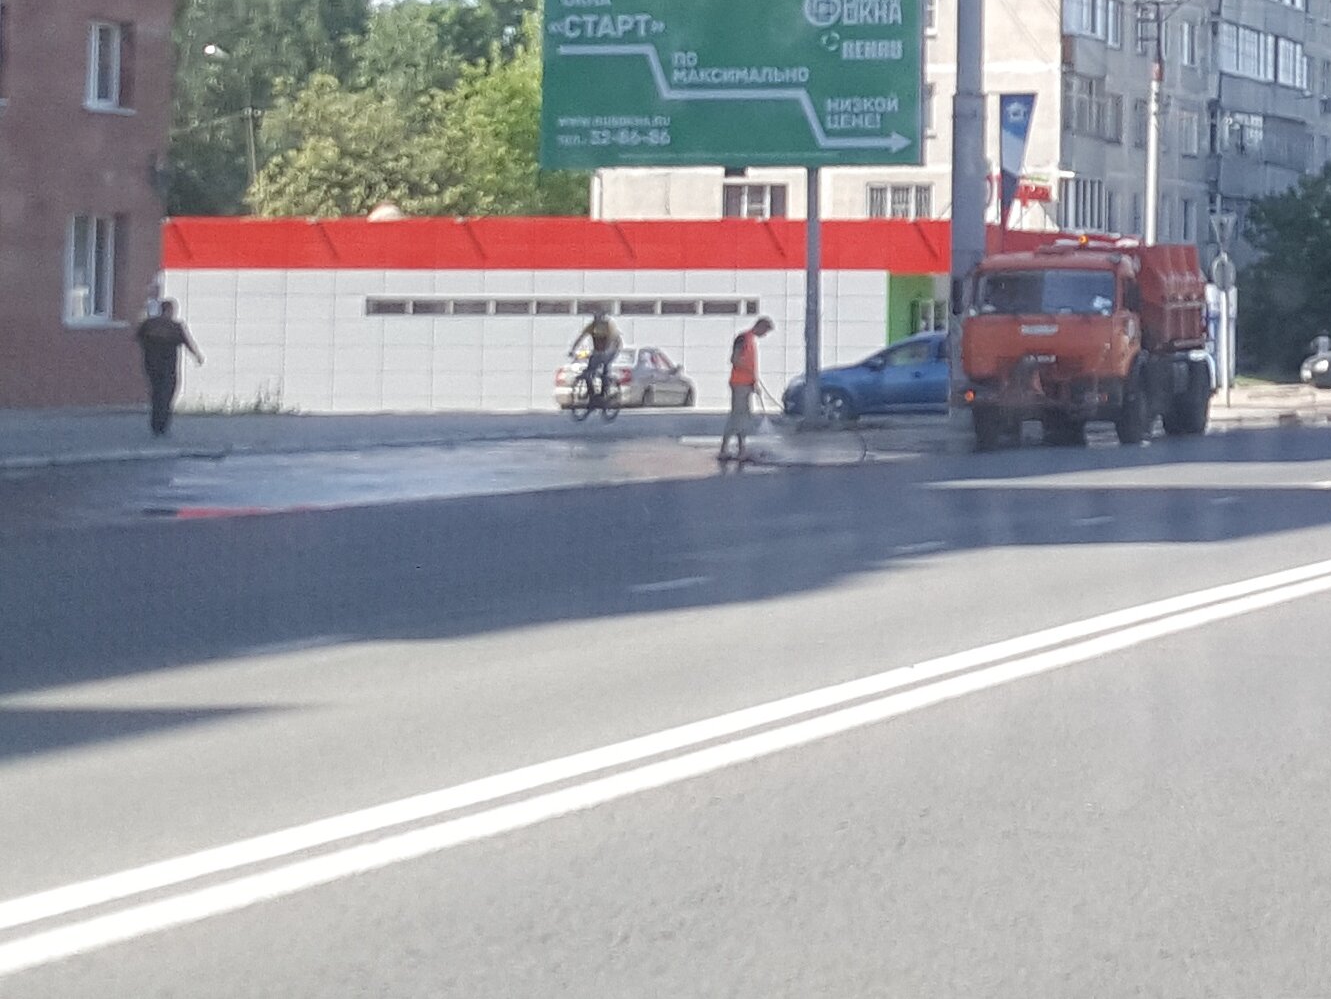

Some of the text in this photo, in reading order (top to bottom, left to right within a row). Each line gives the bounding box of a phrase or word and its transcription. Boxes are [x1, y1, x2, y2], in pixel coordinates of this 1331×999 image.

[843, 3, 902, 24] ОКНА
[548, 14, 666, 38] «СТАРТ»
[672, 52, 698, 67] ПО
[673, 67, 810, 84] МАКСИМАЛЬНО
[827, 96, 899, 113] НИЗКОЙ
[827, 114, 882, 129] ЦЕНЕ!
